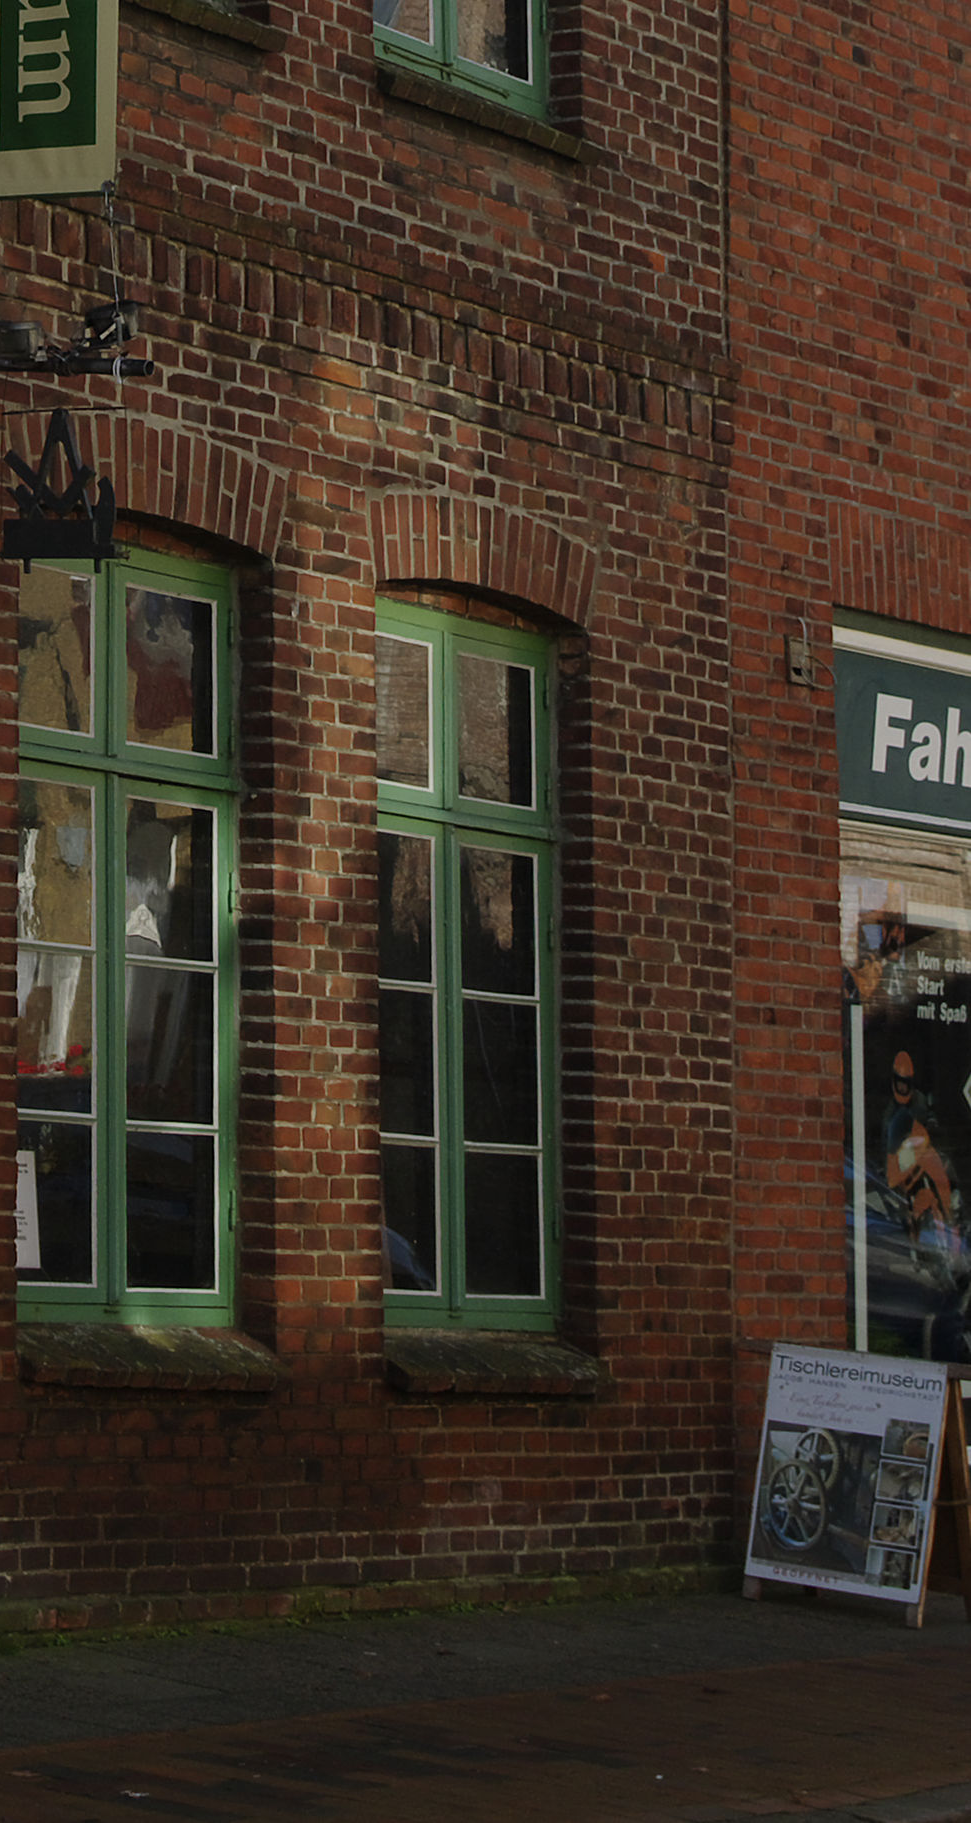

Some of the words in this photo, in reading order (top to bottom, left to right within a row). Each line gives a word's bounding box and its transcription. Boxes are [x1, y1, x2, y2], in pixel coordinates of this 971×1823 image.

[871, 692, 971, 789] Fah
[917, 951, 940, 971] Vom
[917, 975, 945, 996] Start
[917, 1001, 935, 1020] mit
[939, 1002, 967, 1025] Spaß
[775, 1354, 943, 1393] Tischlereimuseum
